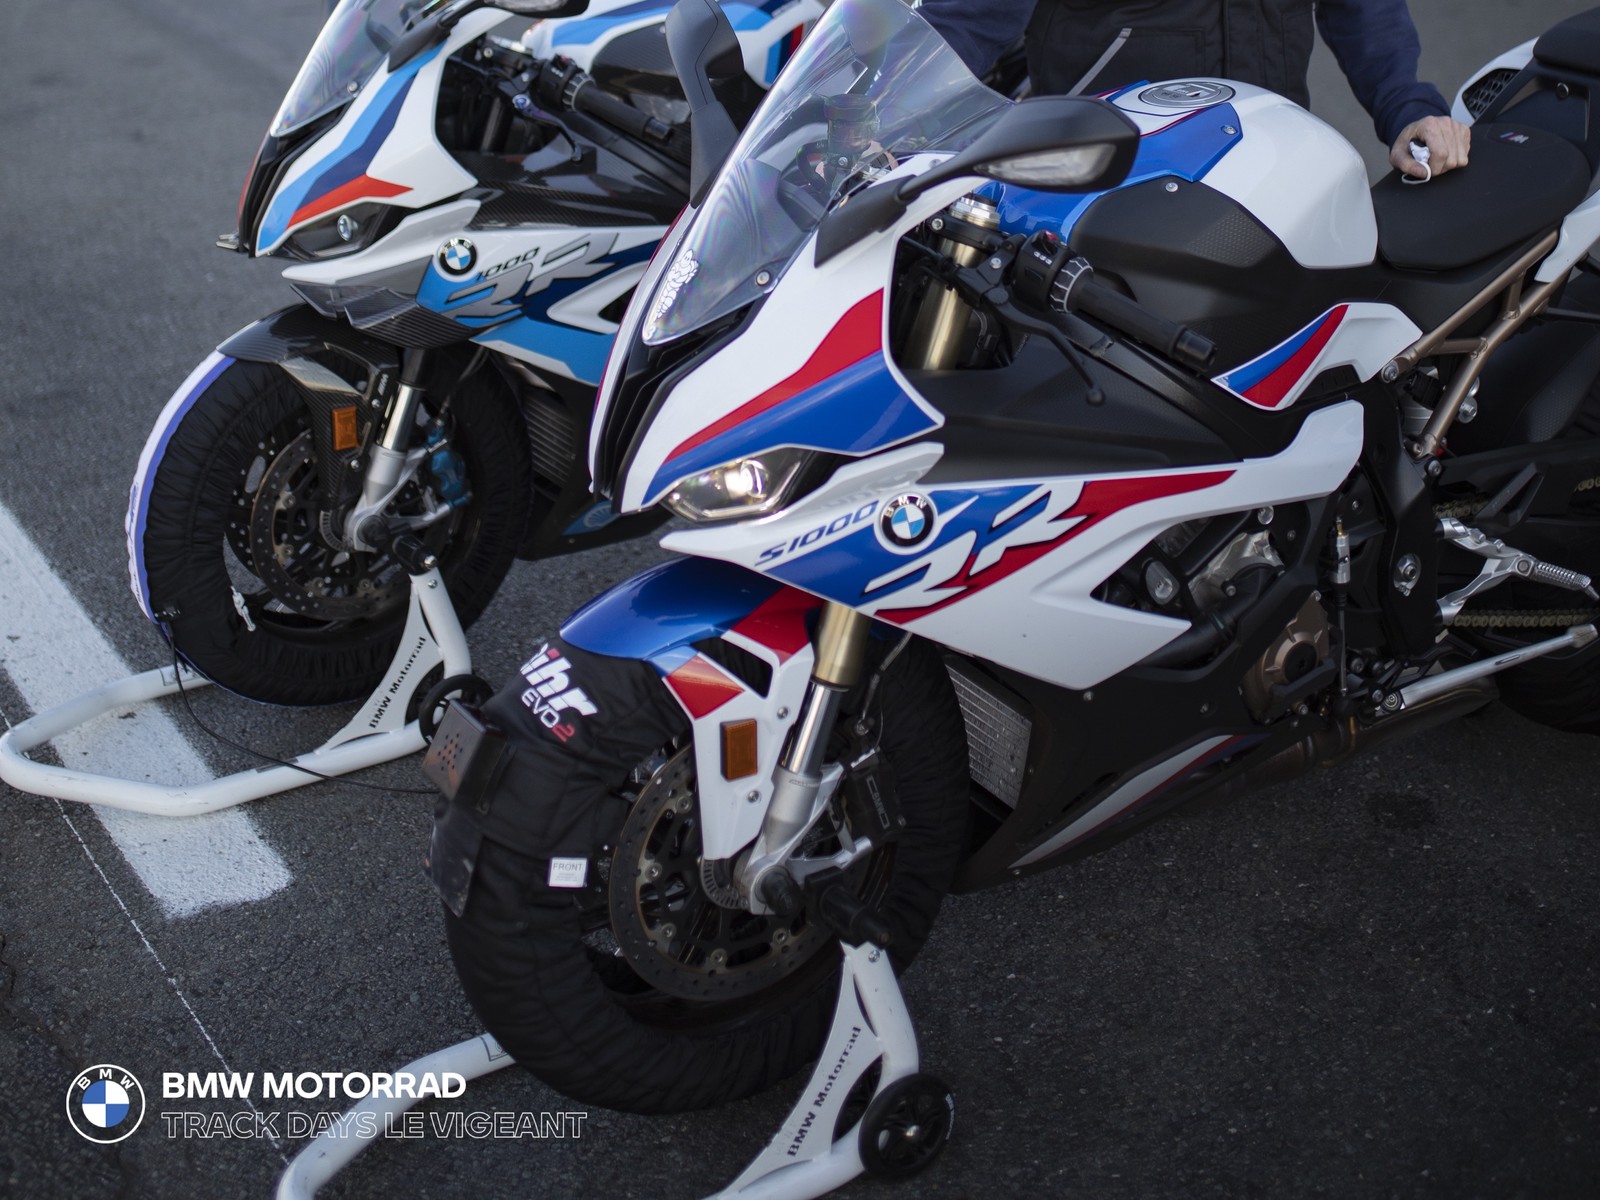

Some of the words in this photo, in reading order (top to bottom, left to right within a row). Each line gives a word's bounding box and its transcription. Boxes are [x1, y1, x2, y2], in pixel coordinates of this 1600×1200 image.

[754, 499, 880, 568] S1000
[884, 495, 928, 517] BMW
[368, 696, 392, 729] BMW
[389, 636, 427, 694] Motorrad
[520, 642, 598, 716] ihr
[552, 863, 583, 872] FRONT
[787, 1111, 816, 1157] BMW
[813, 1026, 861, 1108] Motorrad
